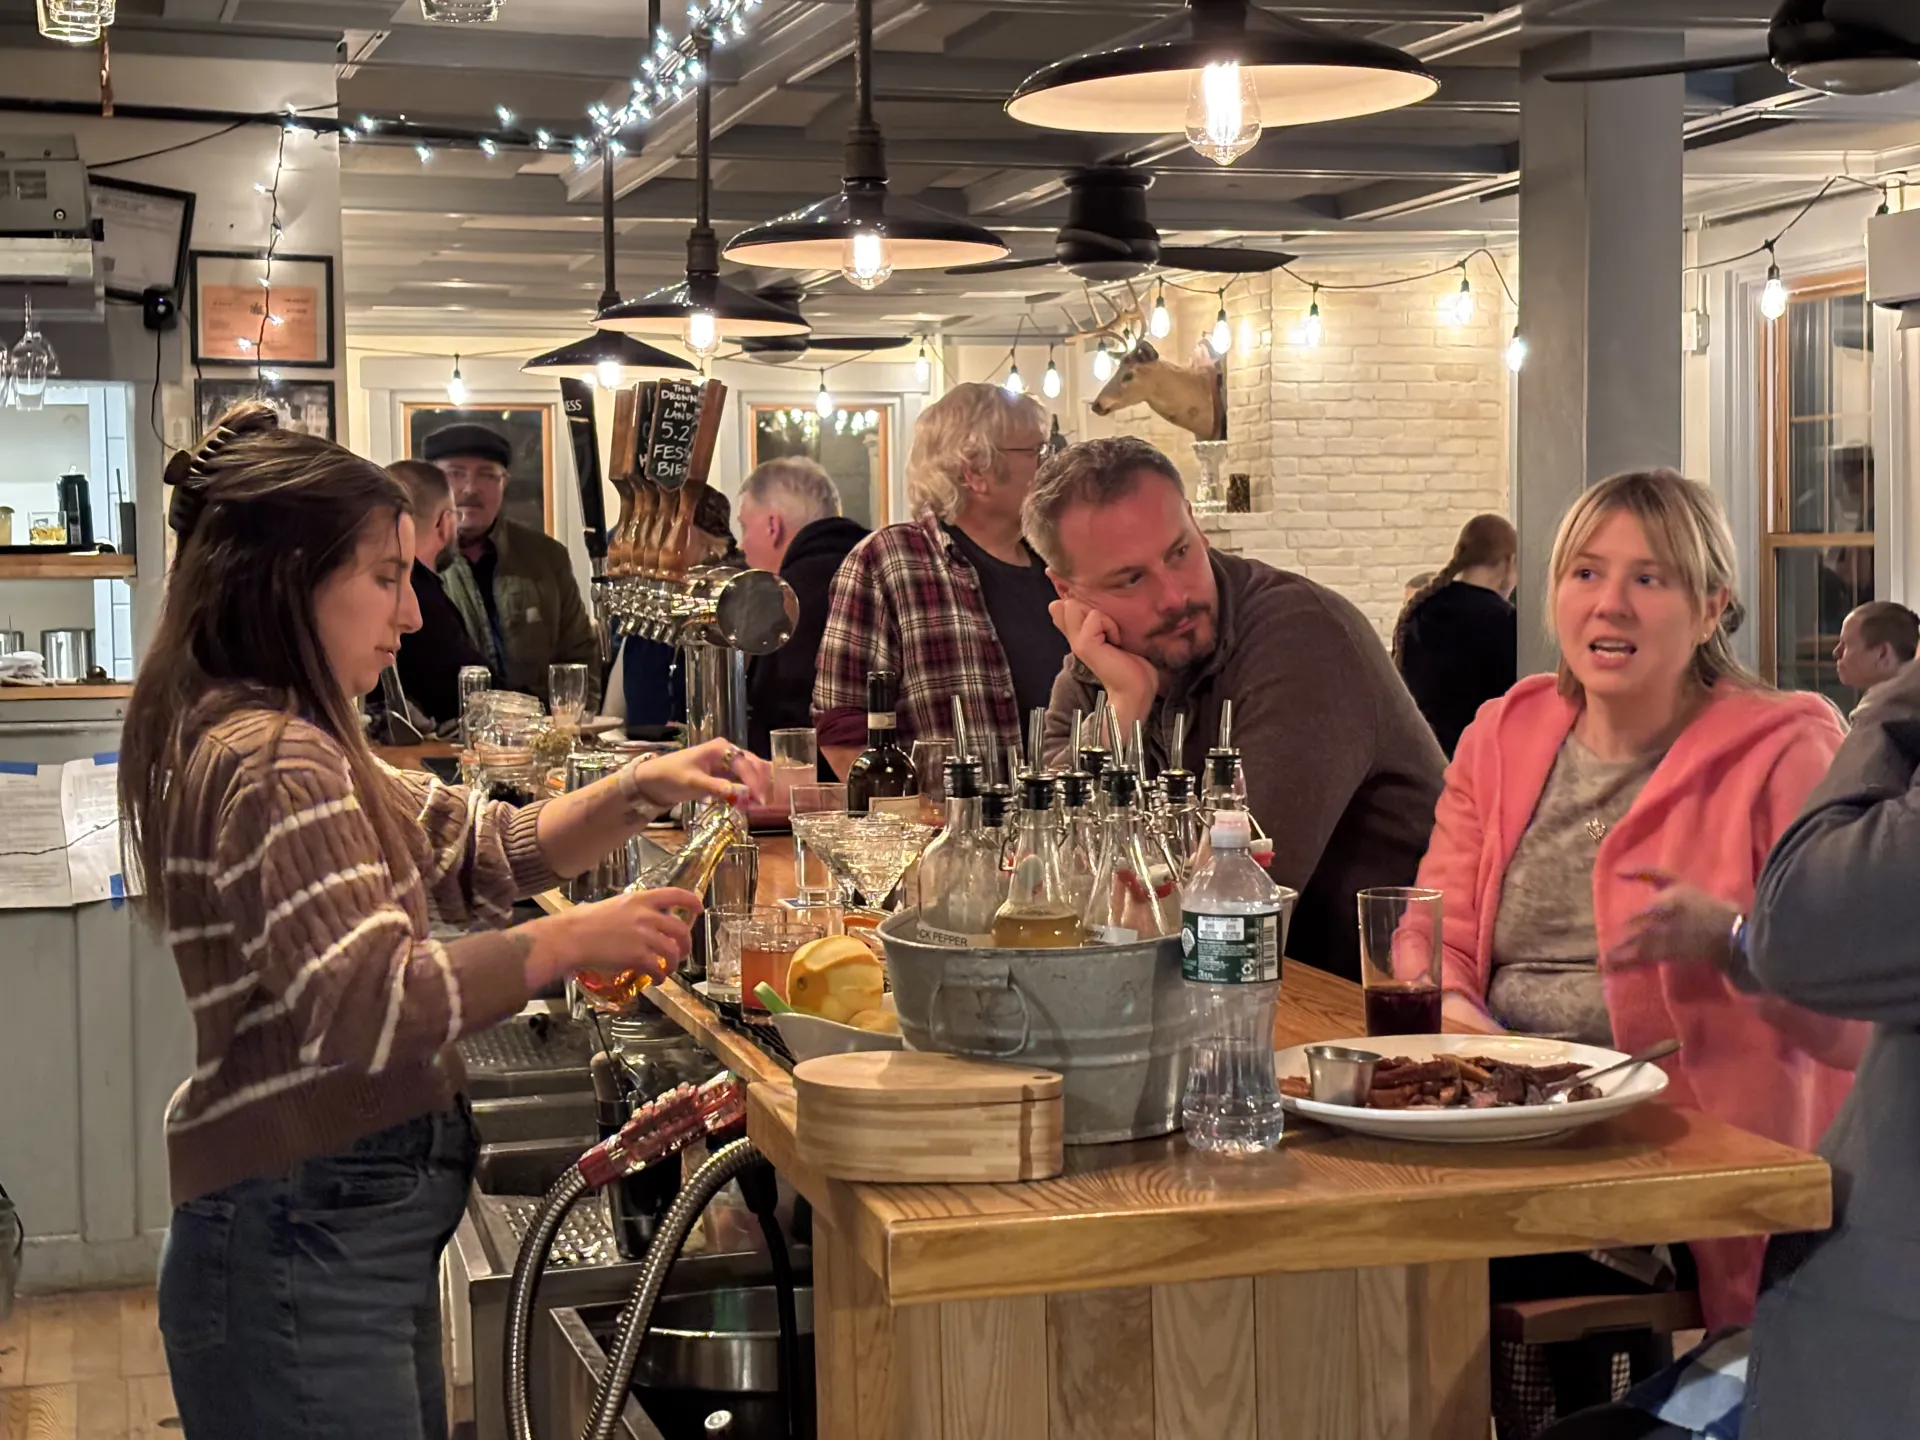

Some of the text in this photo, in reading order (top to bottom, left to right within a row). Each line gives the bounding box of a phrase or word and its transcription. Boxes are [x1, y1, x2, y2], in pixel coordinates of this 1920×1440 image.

[564, 399, 582, 411] ESS
[918, 928, 968, 947] CK PEPPER
